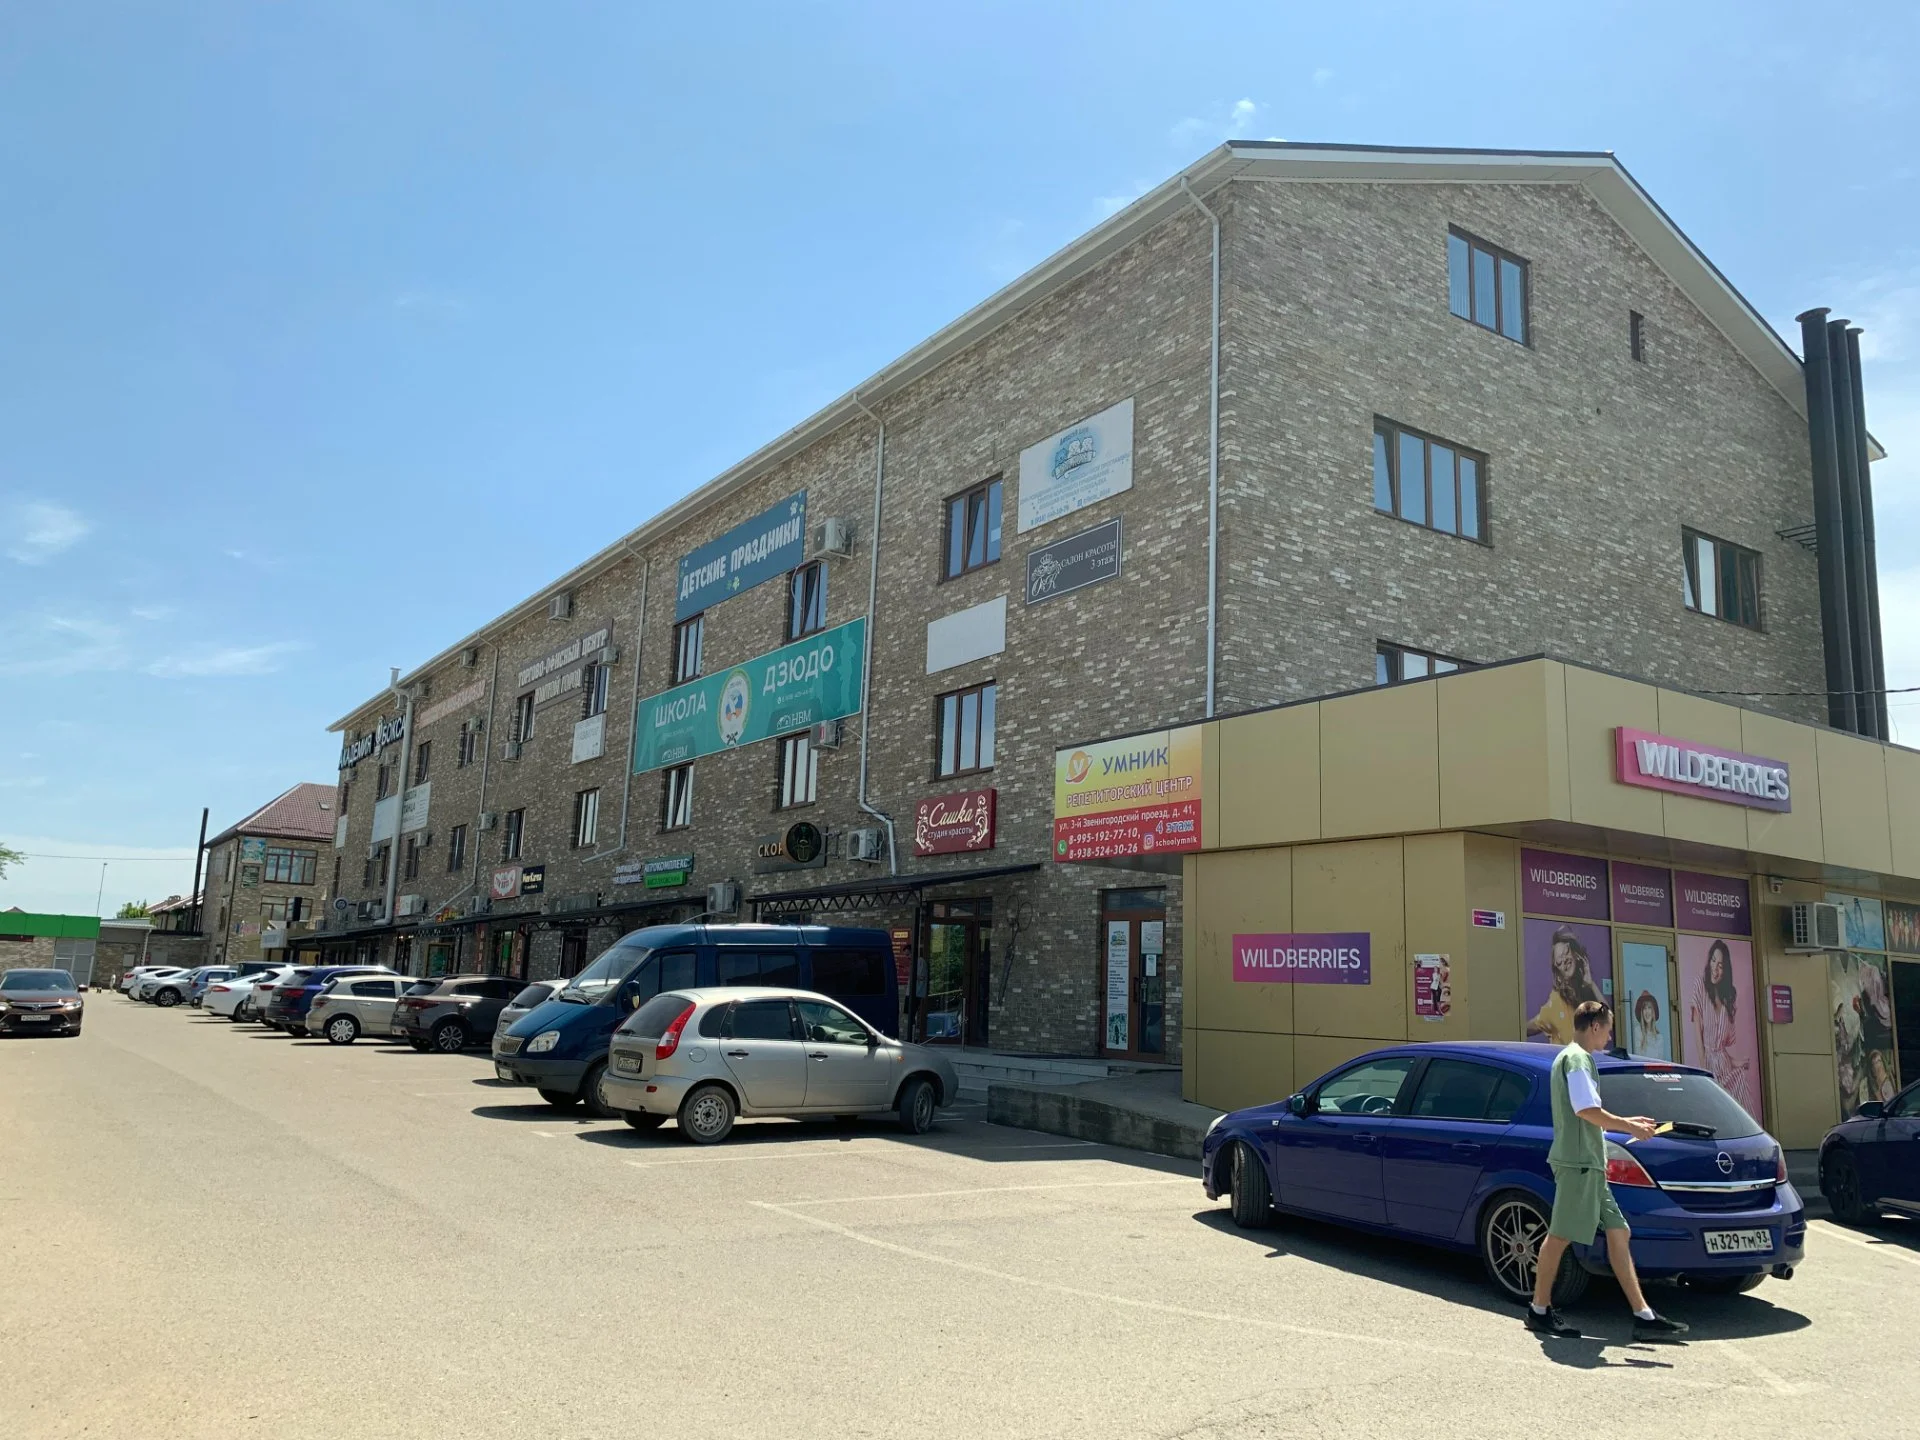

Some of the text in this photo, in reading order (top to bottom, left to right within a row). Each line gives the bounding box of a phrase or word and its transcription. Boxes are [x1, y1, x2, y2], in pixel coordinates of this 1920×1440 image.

[680, 516, 800, 601] ДЕТСКИЕ ПРАЗДНИКИ
[1061, 540, 1116, 569] САЛОН КРАСОТЫ
[1090, 554, 1115, 570] 3 этаж
[655, 645, 834, 728] ШКОЛА ДЗЮДО
[339, 714, 407, 769] АКАДЕМИЯ БОКСА
[1102, 747, 1168, 775] УМНИК
[1634, 739, 1790, 801] WILDBERRIES
[1066, 776, 1193, 808] РЕПЕТИТОРСКИЙ ЦЕНТР
[929, 797, 974, 828] Сашка
[1059, 823, 1069, 832] ул.
[1071, 817, 1082, 829] 3-й
[1083, 811, 1140, 828] Звенигородский
[1183, 804, 1196, 815] 41,
[927, 827, 974, 841] студия красоты
[1069, 828, 1140, 845] 8-995-192-77-10,
[1156, 819, 1195, 834] 4 этаж
[1069, 843, 1138, 859] 8-938-524-30-26
[1155, 836, 1198, 847] schoolymnik
[1530, 868, 1597, 890] WILDBERRIES
[1619, 883, 1665, 899] WILDBERRIES
[1684, 889, 1741, 908] WILDBERRIES
[1241, 948, 1361, 969] WILDBERRIES
[1755, 1231, 1768, 1243] 93
